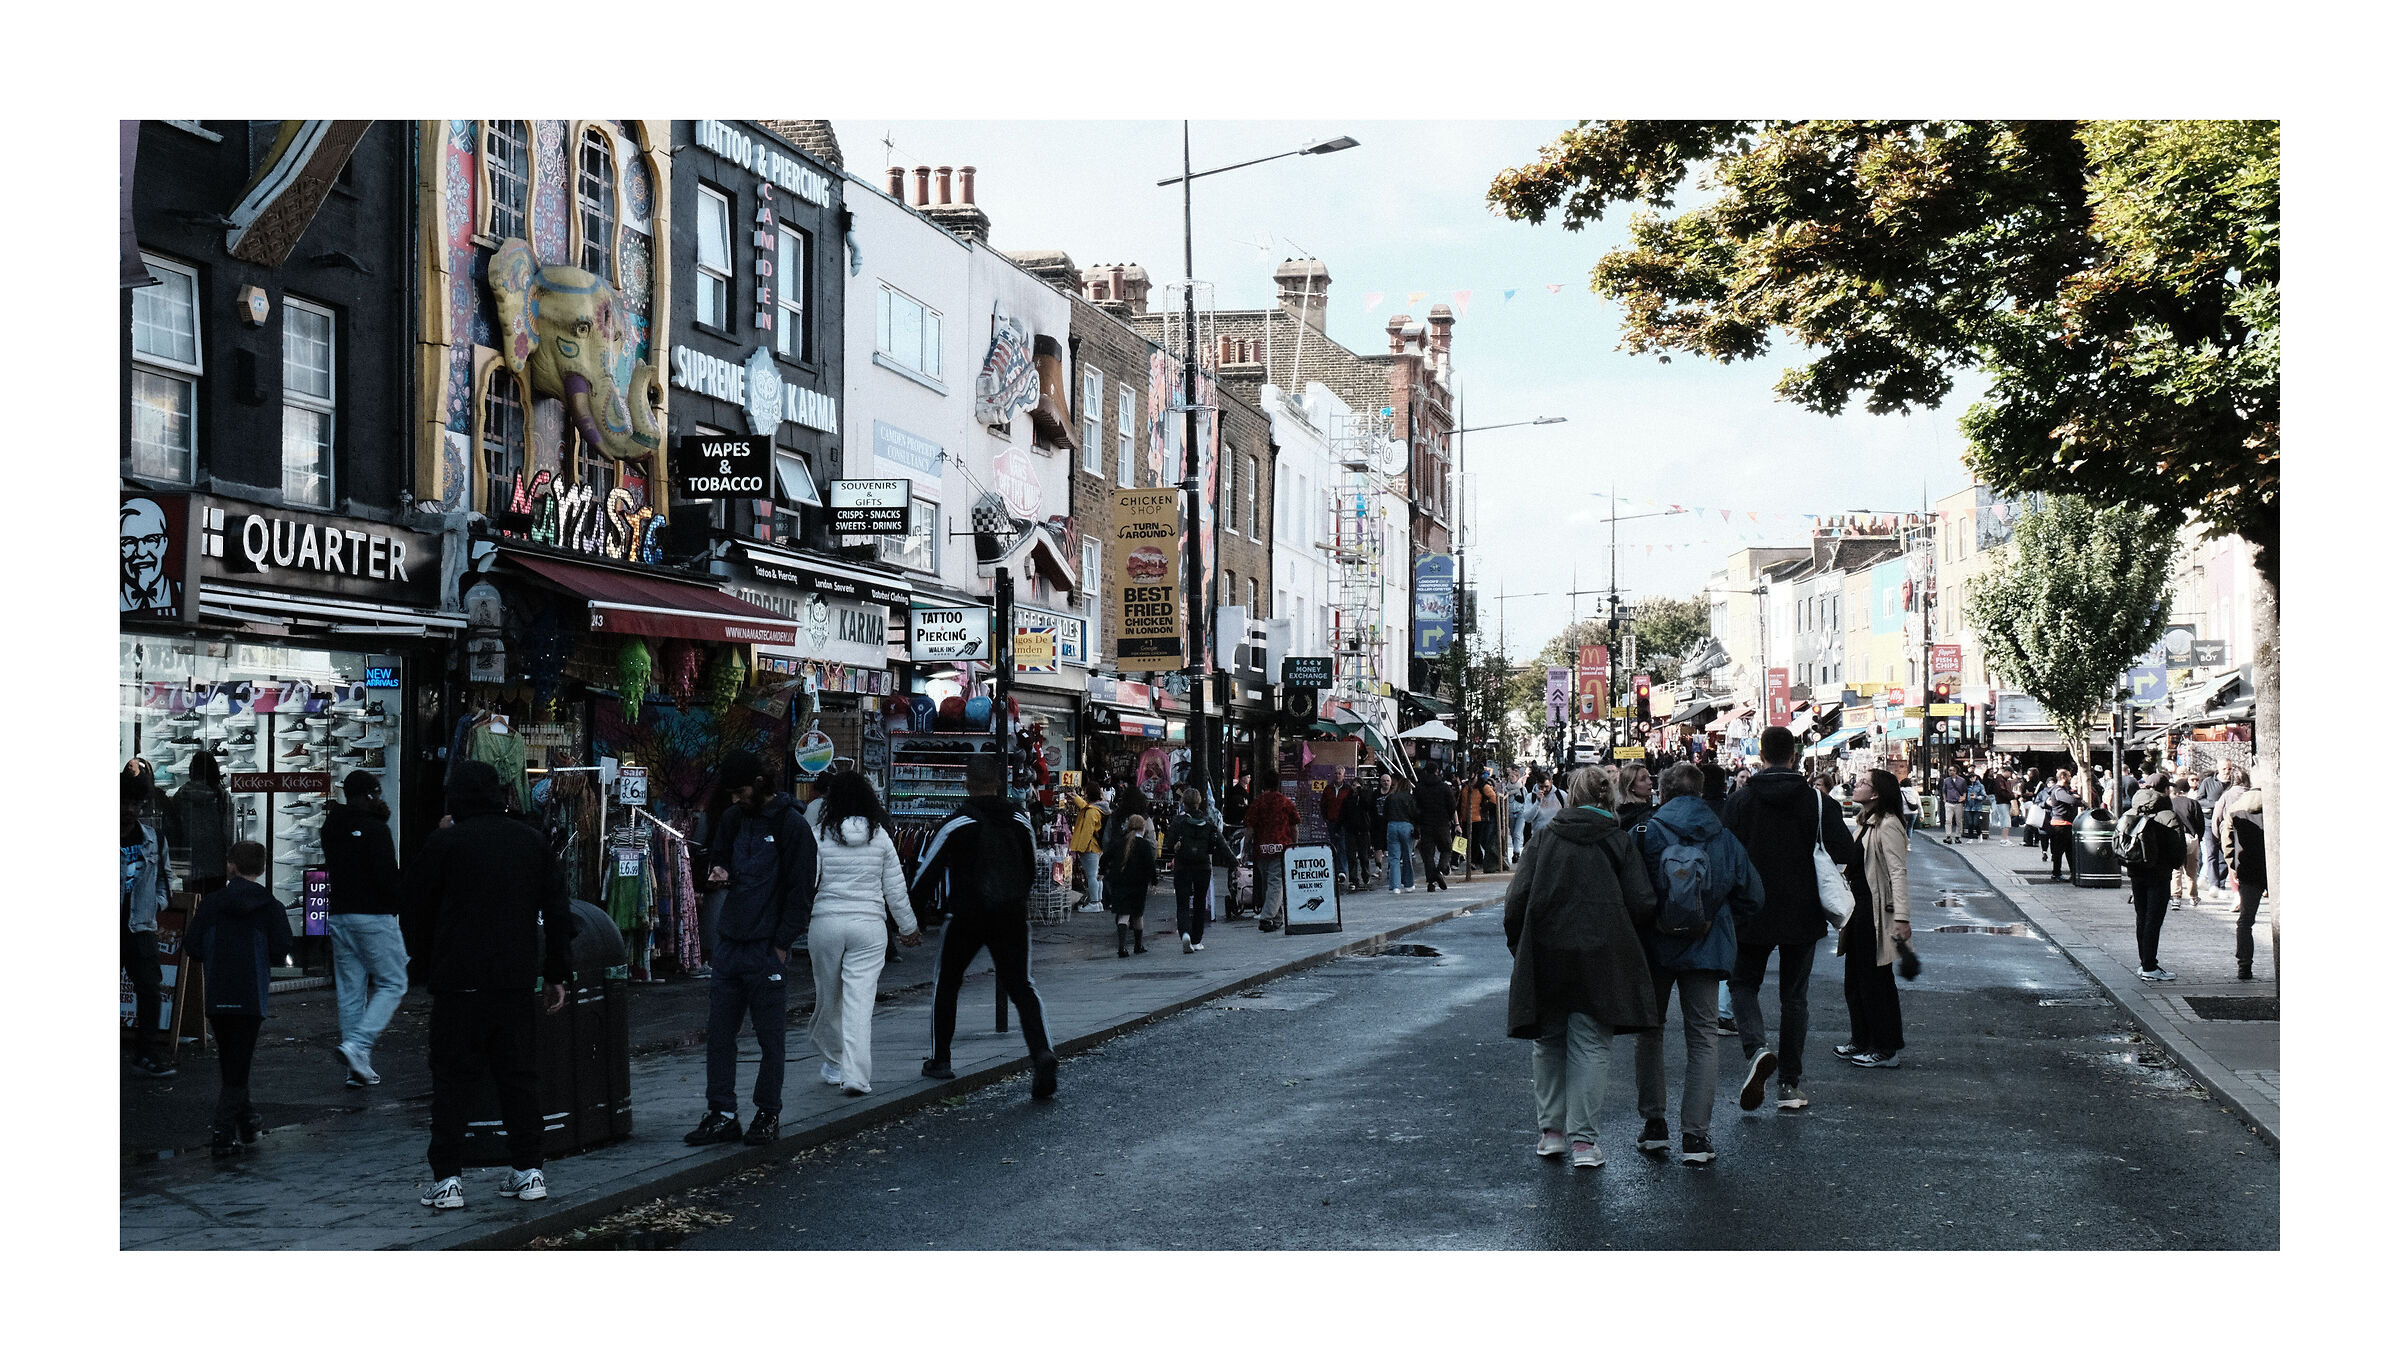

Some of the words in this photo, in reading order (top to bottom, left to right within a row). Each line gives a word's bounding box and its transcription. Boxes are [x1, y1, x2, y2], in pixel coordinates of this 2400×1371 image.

[697, 120, 752, 169] TATTOO
[754, 144, 767, 178] &
[769, 151, 830, 209] PIERCING
[757, 182, 775, 331] CAMDEN
[673, 344, 745, 405] SUPREME
[786, 382, 838, 435] KARMA
[701, 442, 751, 457] VAPES
[719, 459, 732, 474] &
[689, 476, 763, 492] TOBACCO
[841, 482, 897, 490] SOUVENIRS
[855, 498, 882, 506] GIFTS
[1120, 495, 1173, 506] CHICKEN
[837, 510, 864, 519] CRISPS
[870, 510, 901, 519] SNACKS
[1131, 505, 1162, 515] SHOP
[835, 521, 866, 531] SWEETS
[872, 521, 902, 531] DRINKS
[1133, 522, 1160, 531] TURN
[1125, 530, 1167, 539] AROUND
[243, 514, 410, 583] QUARTER
[772, 569, 777, 579] &
[778, 570, 798, 584] Piercing
[1124, 586, 1173, 602] BEST
[1124, 602, 1173, 617] FRIED
[591, 614, 604, 627] 243
[921, 611, 963, 625] TATTOO
[1125, 617, 1173, 627] CHICKEN
[839, 608, 884, 647] KARMA
[1125, 626, 1135, 635] IN
[1136, 625, 1173, 635] LONDON
[917, 627, 967, 642] PIERCING
[1035, 635, 1048, 644] De
[2201, 654, 2217, 662] BOY
[366, 668, 392, 679] NEW
[366, 678, 399, 687] ARRIVALS
[620, 852, 638, 860] sale
[1294, 858, 1326, 869] TATTOO
[1291, 868, 1330, 880] PIERCING
[310, 883, 326, 892] UP
